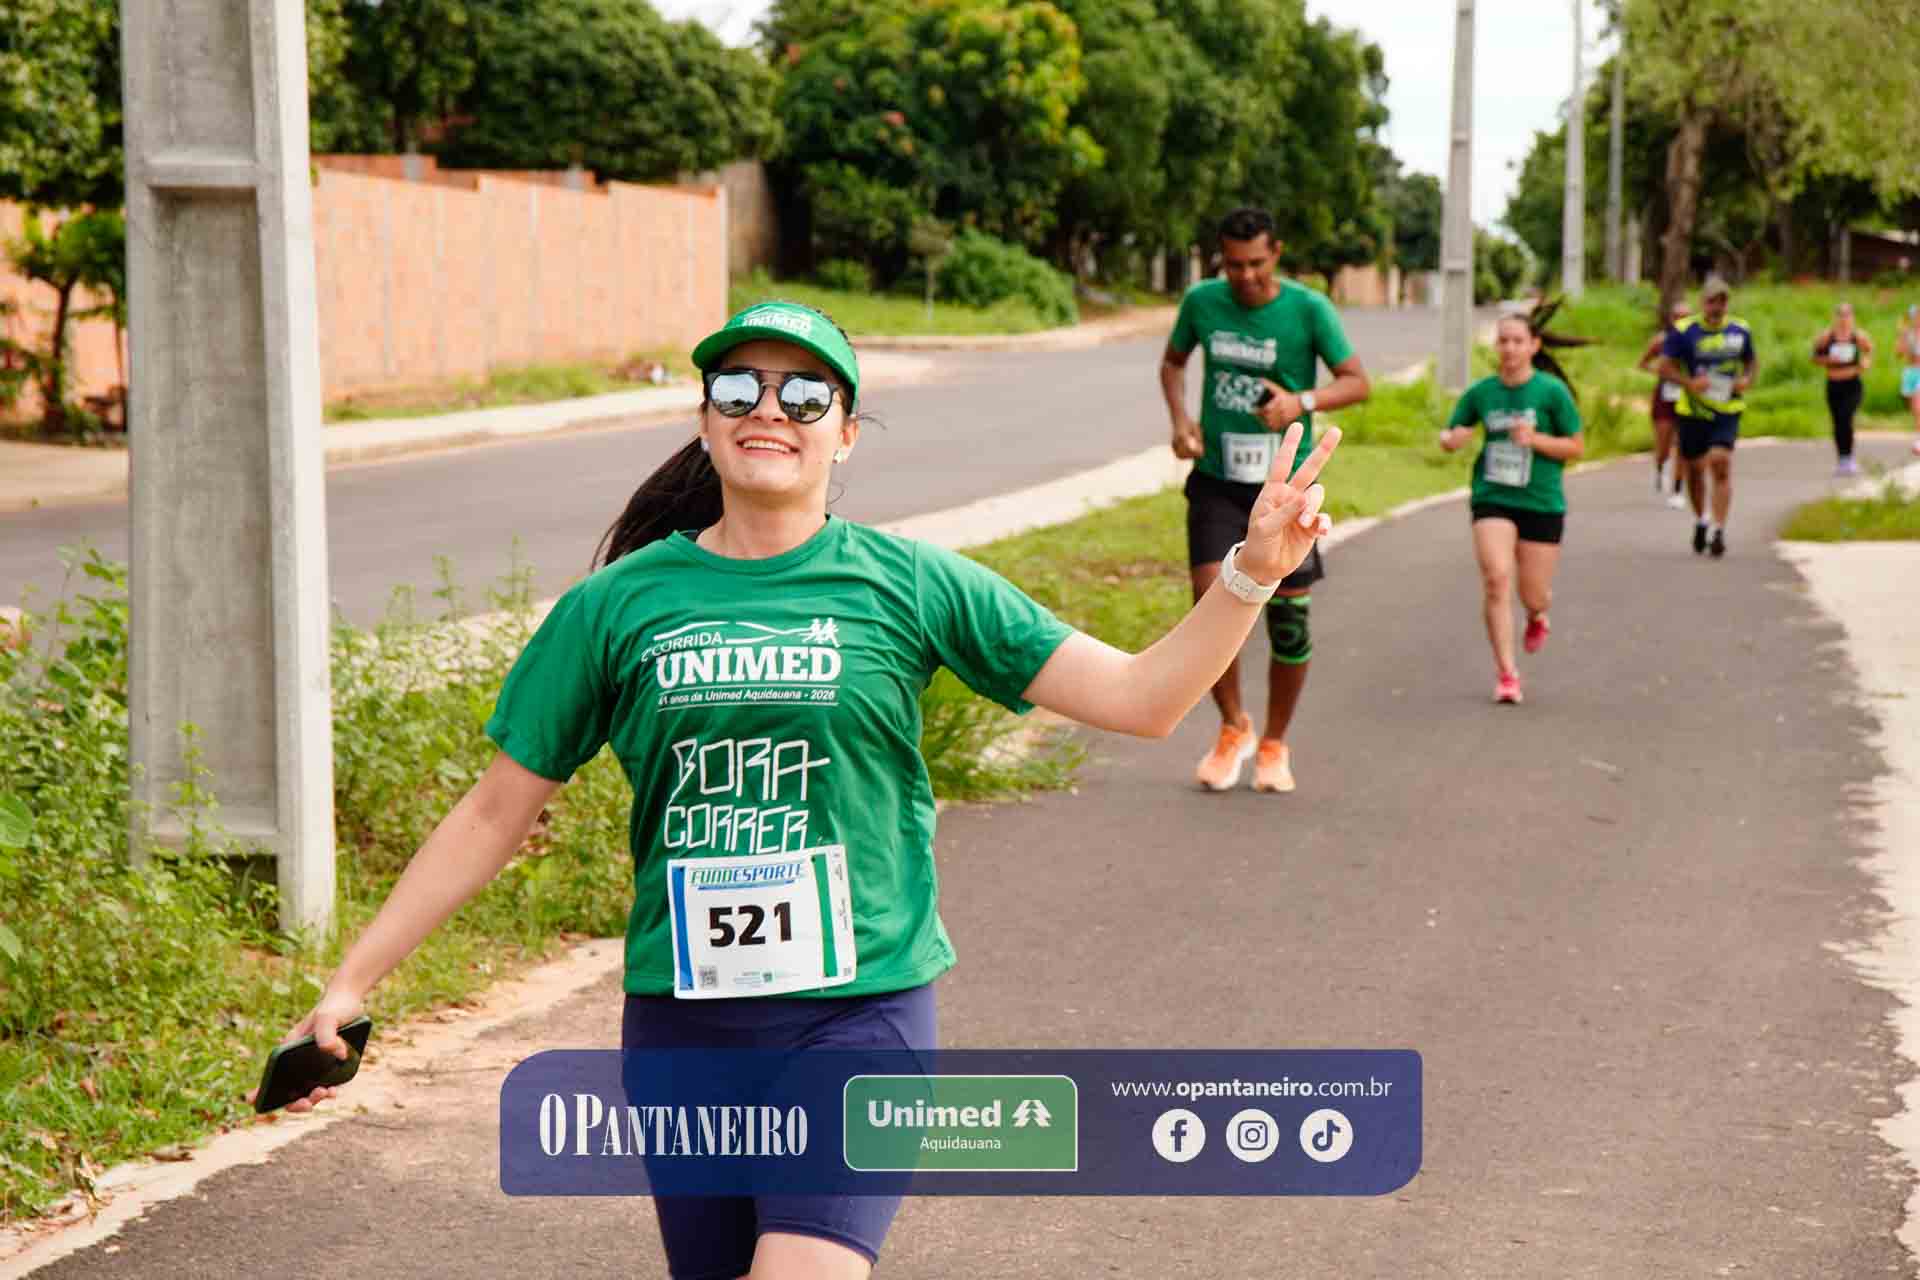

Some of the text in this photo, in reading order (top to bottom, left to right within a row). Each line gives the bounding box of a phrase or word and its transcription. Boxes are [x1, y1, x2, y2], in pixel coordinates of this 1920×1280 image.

[652, 631, 723, 656] CORRIDA
[656, 646, 842, 688] UNIMED
[690, 692, 703, 702] da
[705, 690, 742, 701] Unimed
[743, 688, 801, 701] Aquidauana
[667, 737, 831, 804] BORA
[664, 802, 810, 854] CORRER
[709, 901, 792, 947] 521
